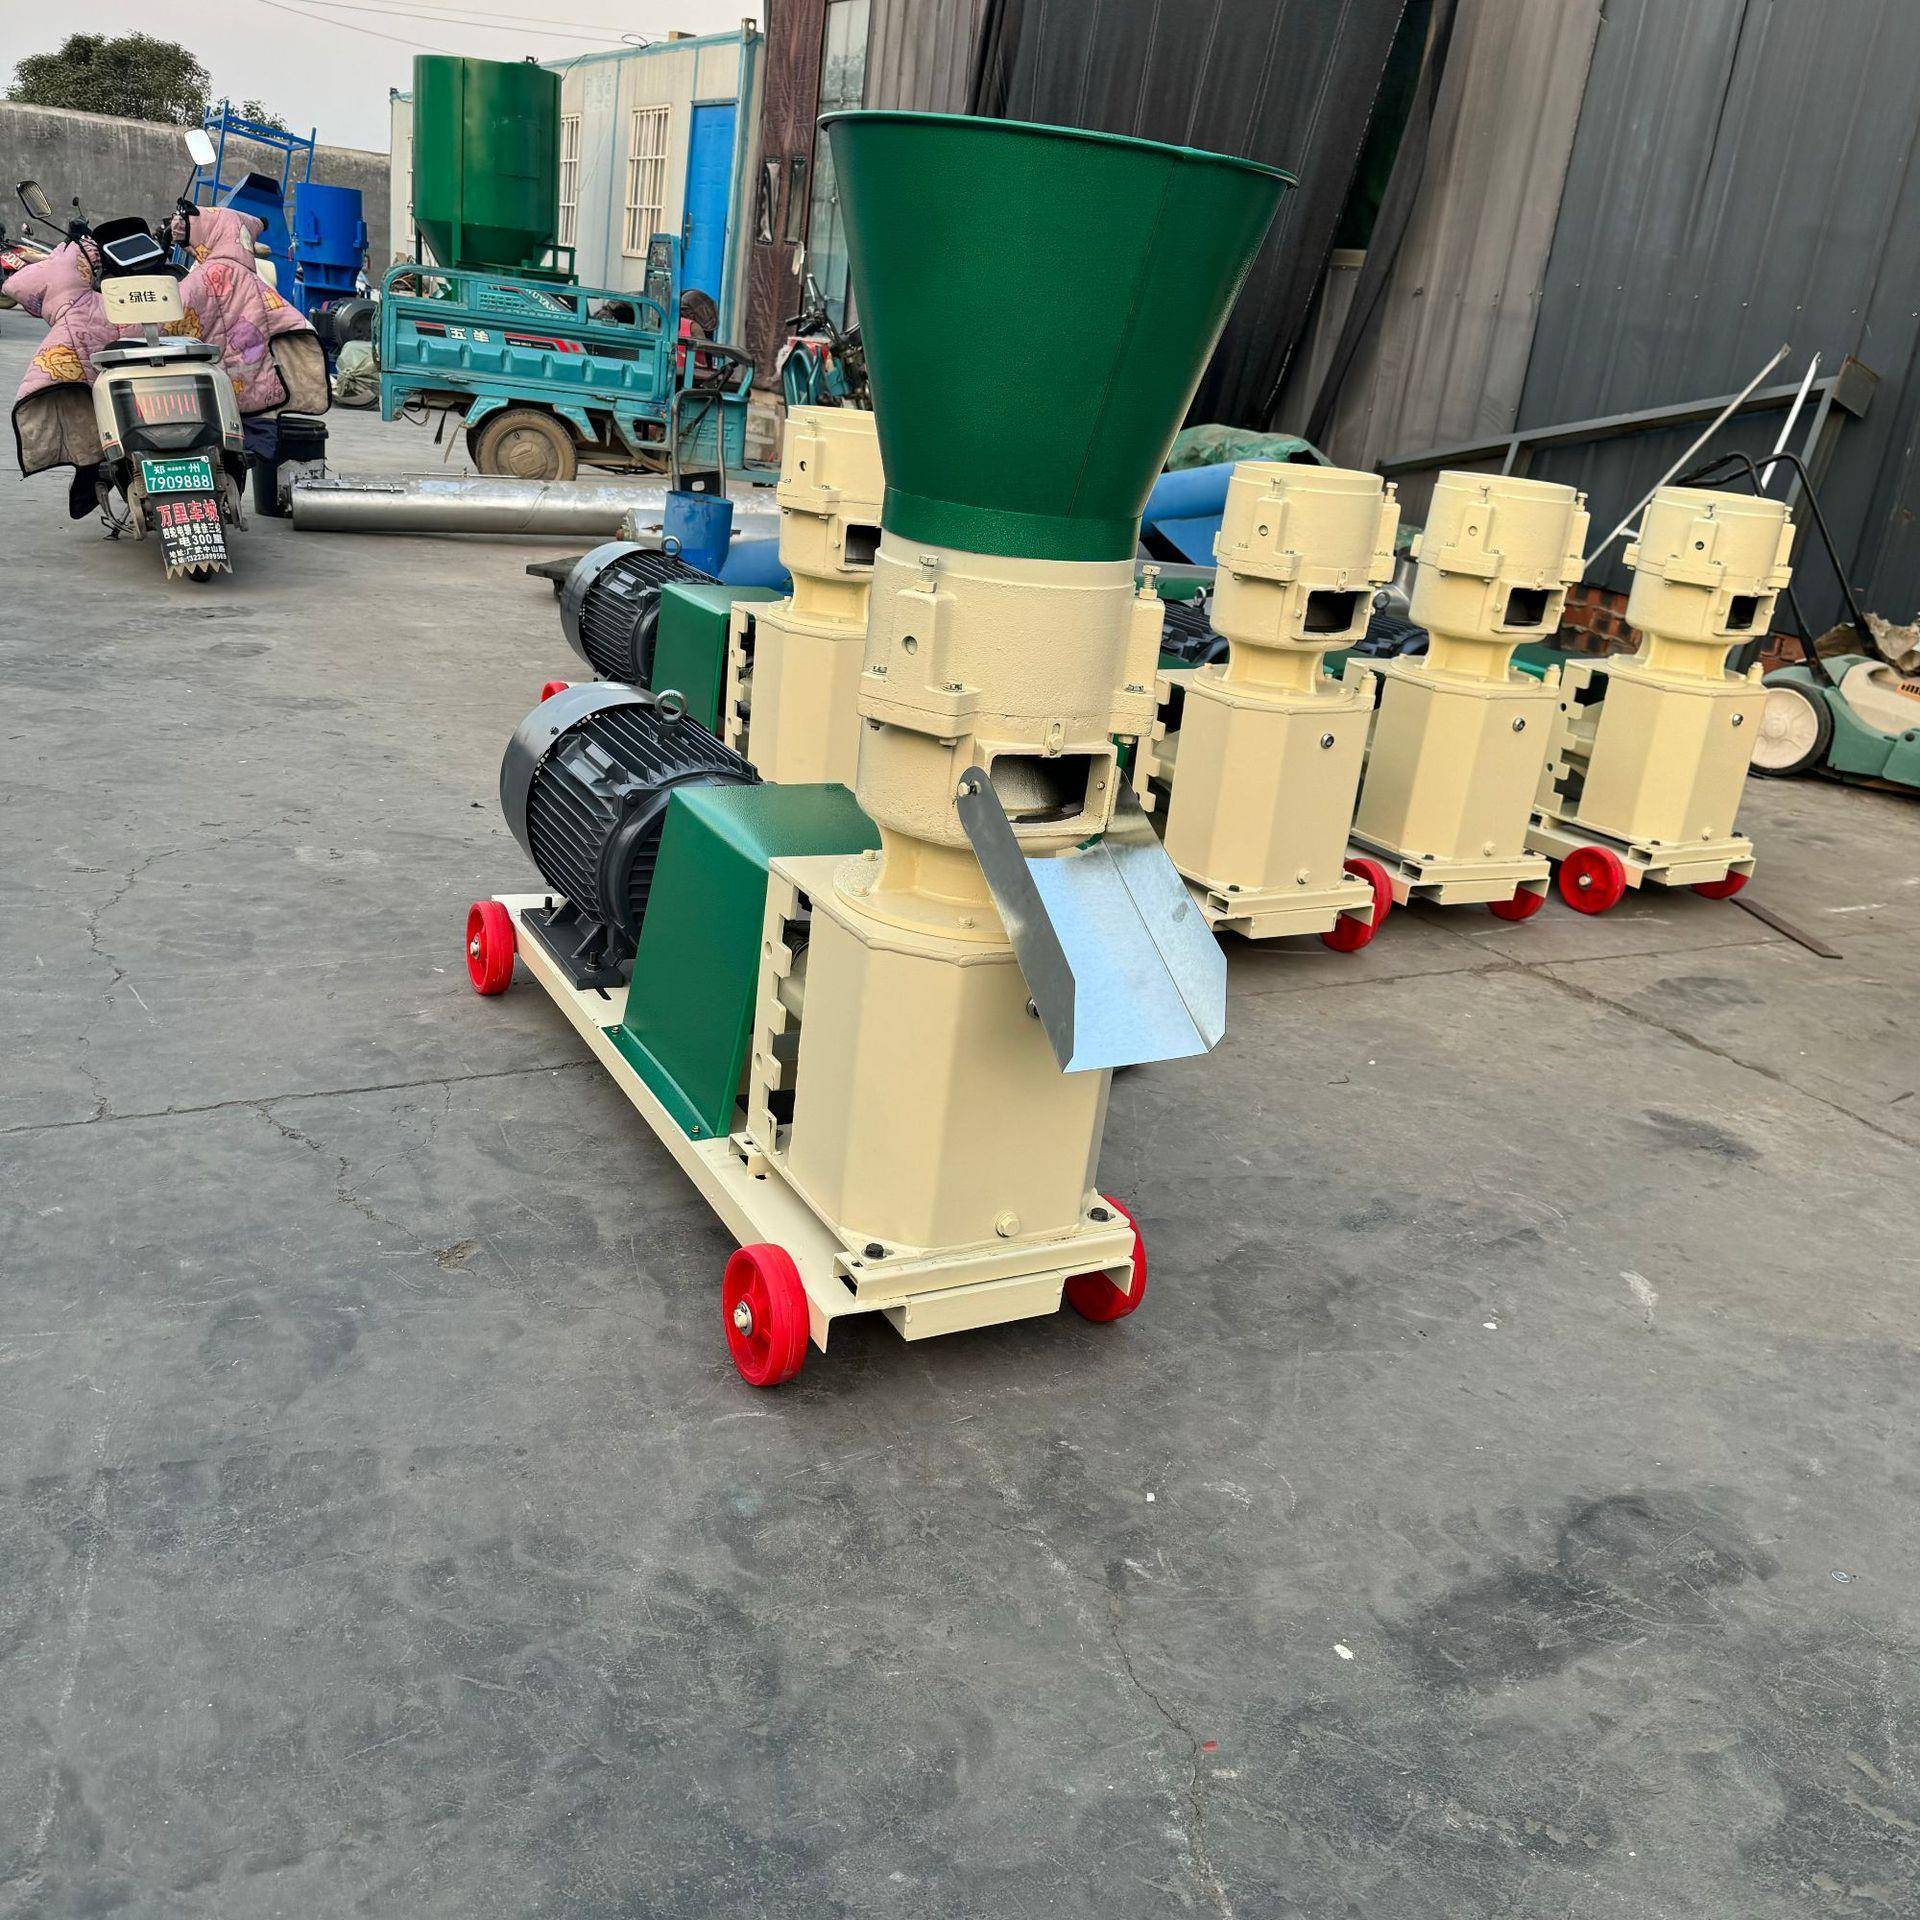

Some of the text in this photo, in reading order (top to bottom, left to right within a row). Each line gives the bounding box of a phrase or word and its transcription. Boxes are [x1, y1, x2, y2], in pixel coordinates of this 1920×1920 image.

[129, 291, 157, 303] 绿佳
[449, 327, 490, 343] 五羊
[188, 463, 200, 473] 州
[148, 475, 210, 490] 7909888
